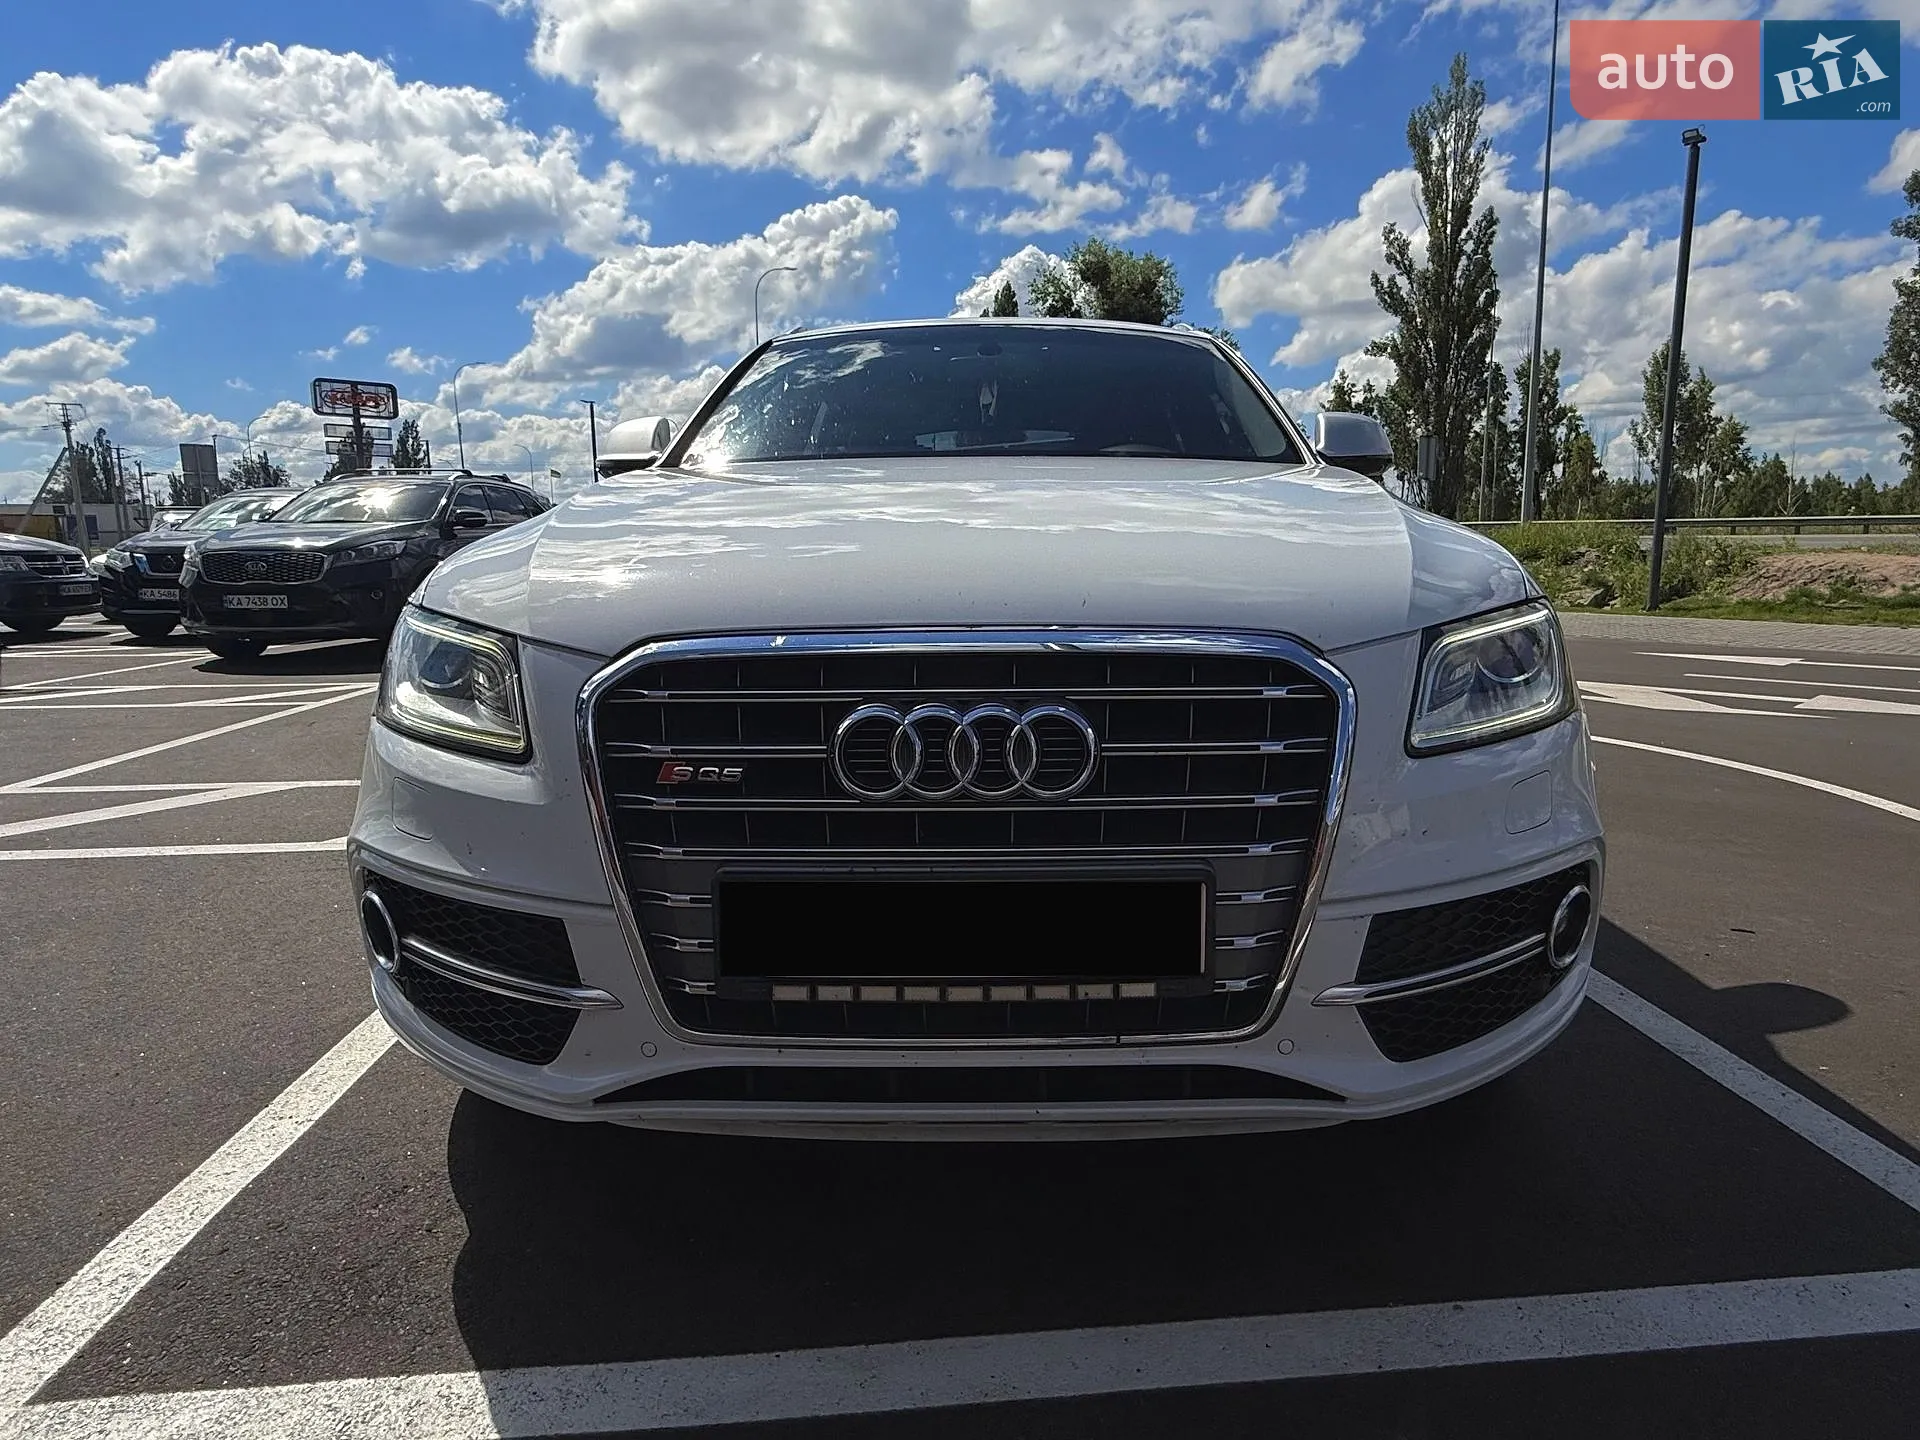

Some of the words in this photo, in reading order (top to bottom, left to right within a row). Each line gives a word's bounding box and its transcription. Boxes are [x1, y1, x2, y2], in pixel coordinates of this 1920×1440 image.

[143, 590, 155, 599] KA
[228, 596, 243, 607] KA
[244, 596, 268, 607] 7438
[270, 596, 287, 607] OX
[671, 766, 743, 782] SQ5
